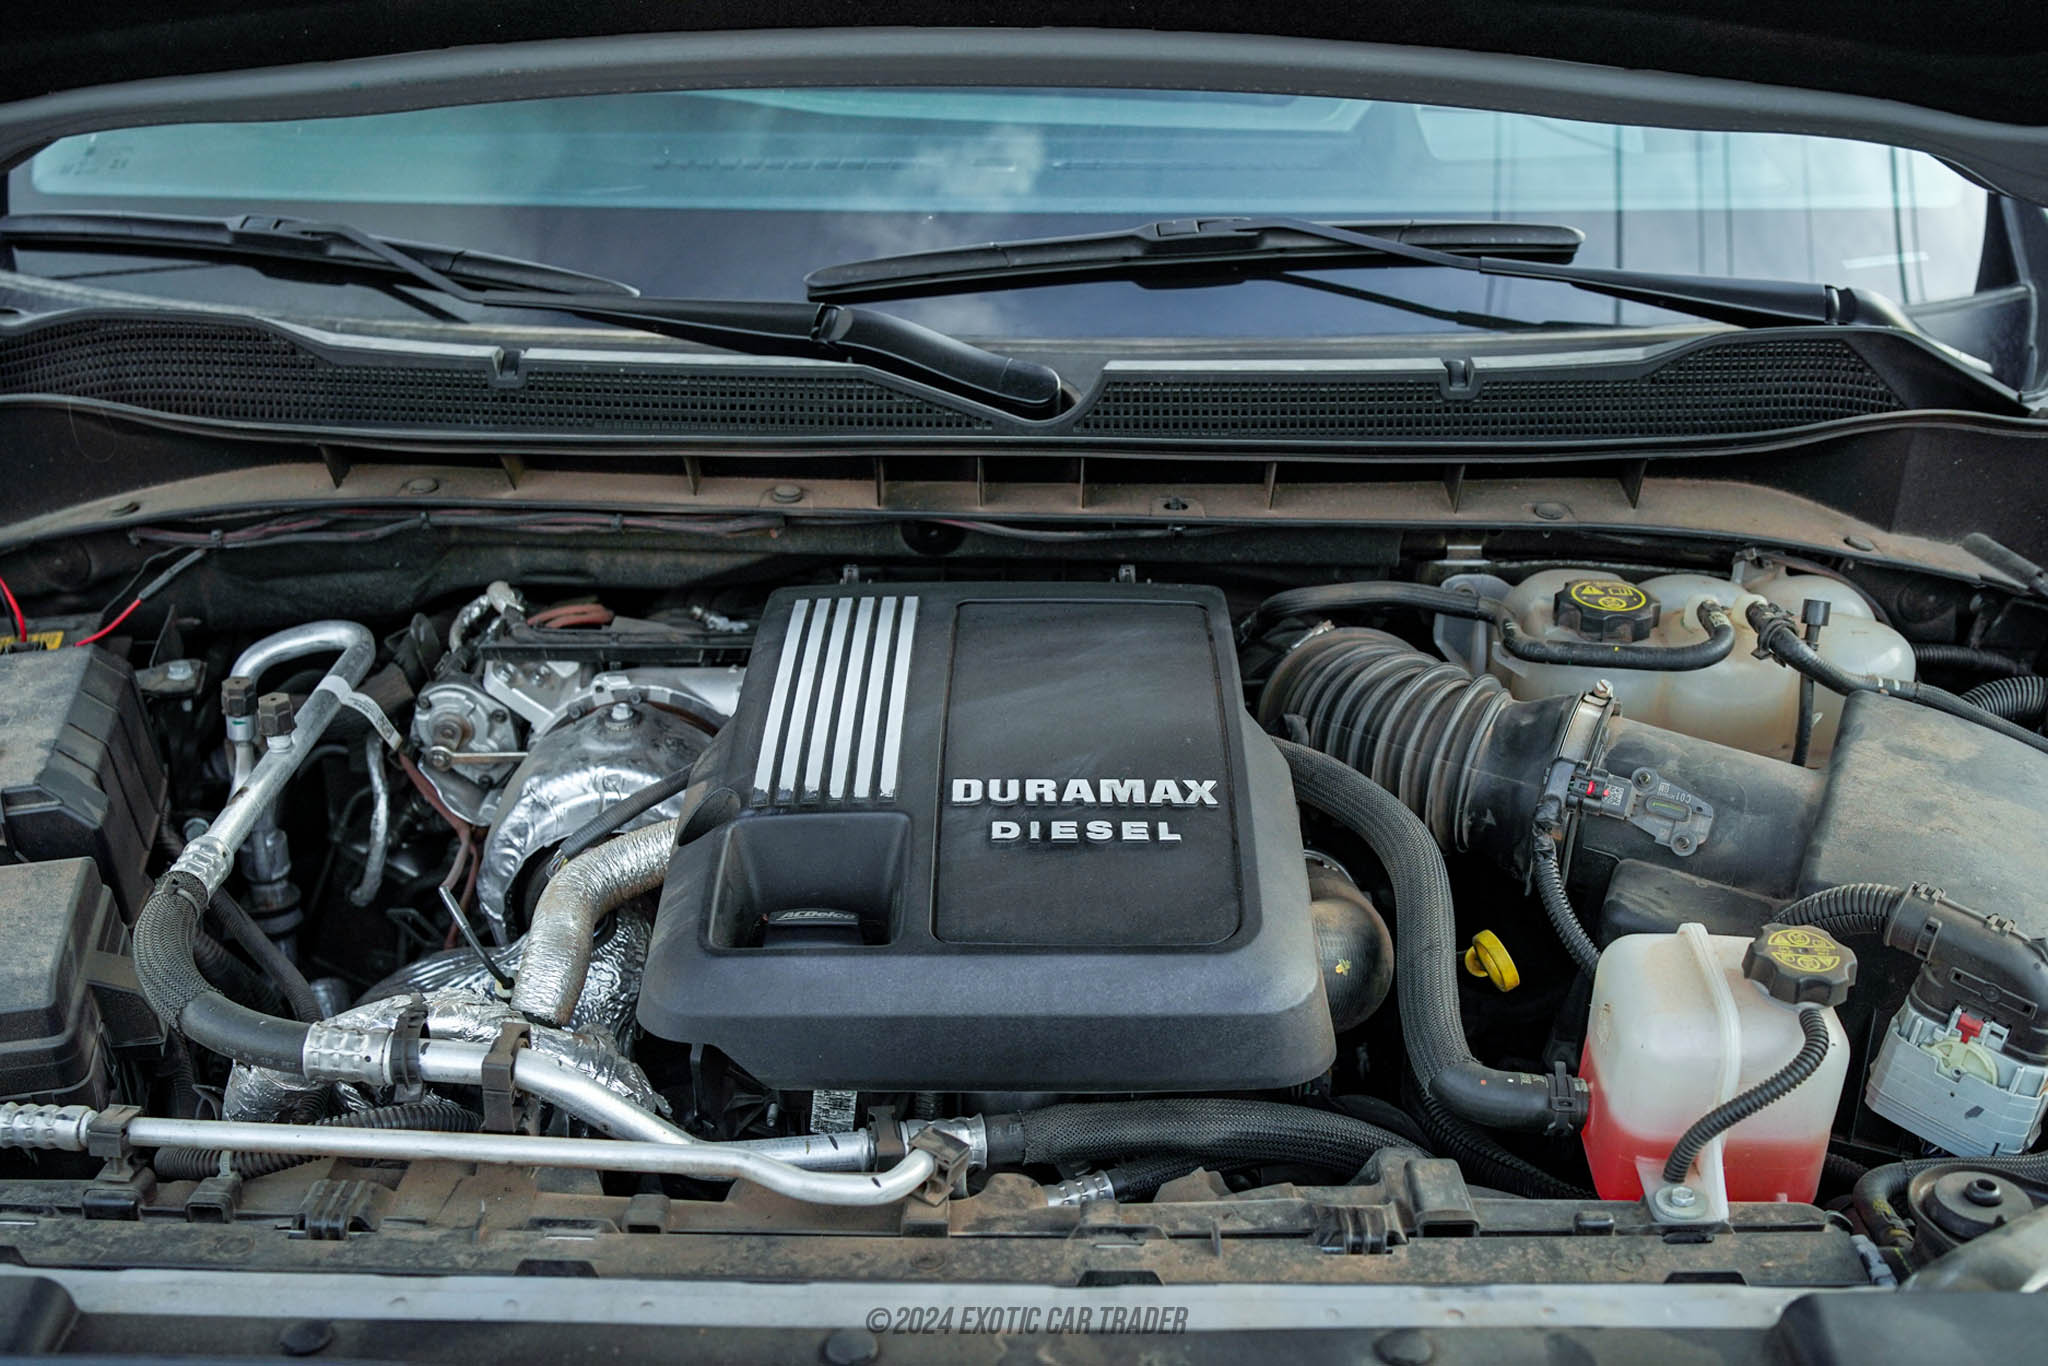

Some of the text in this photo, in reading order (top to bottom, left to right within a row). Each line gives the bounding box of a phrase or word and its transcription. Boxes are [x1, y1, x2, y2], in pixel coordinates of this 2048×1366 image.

[951, 778, 1220, 807] DURAMAX
[990, 820, 1182, 844] DIESEL
[779, 910, 857, 920] ACDelco
